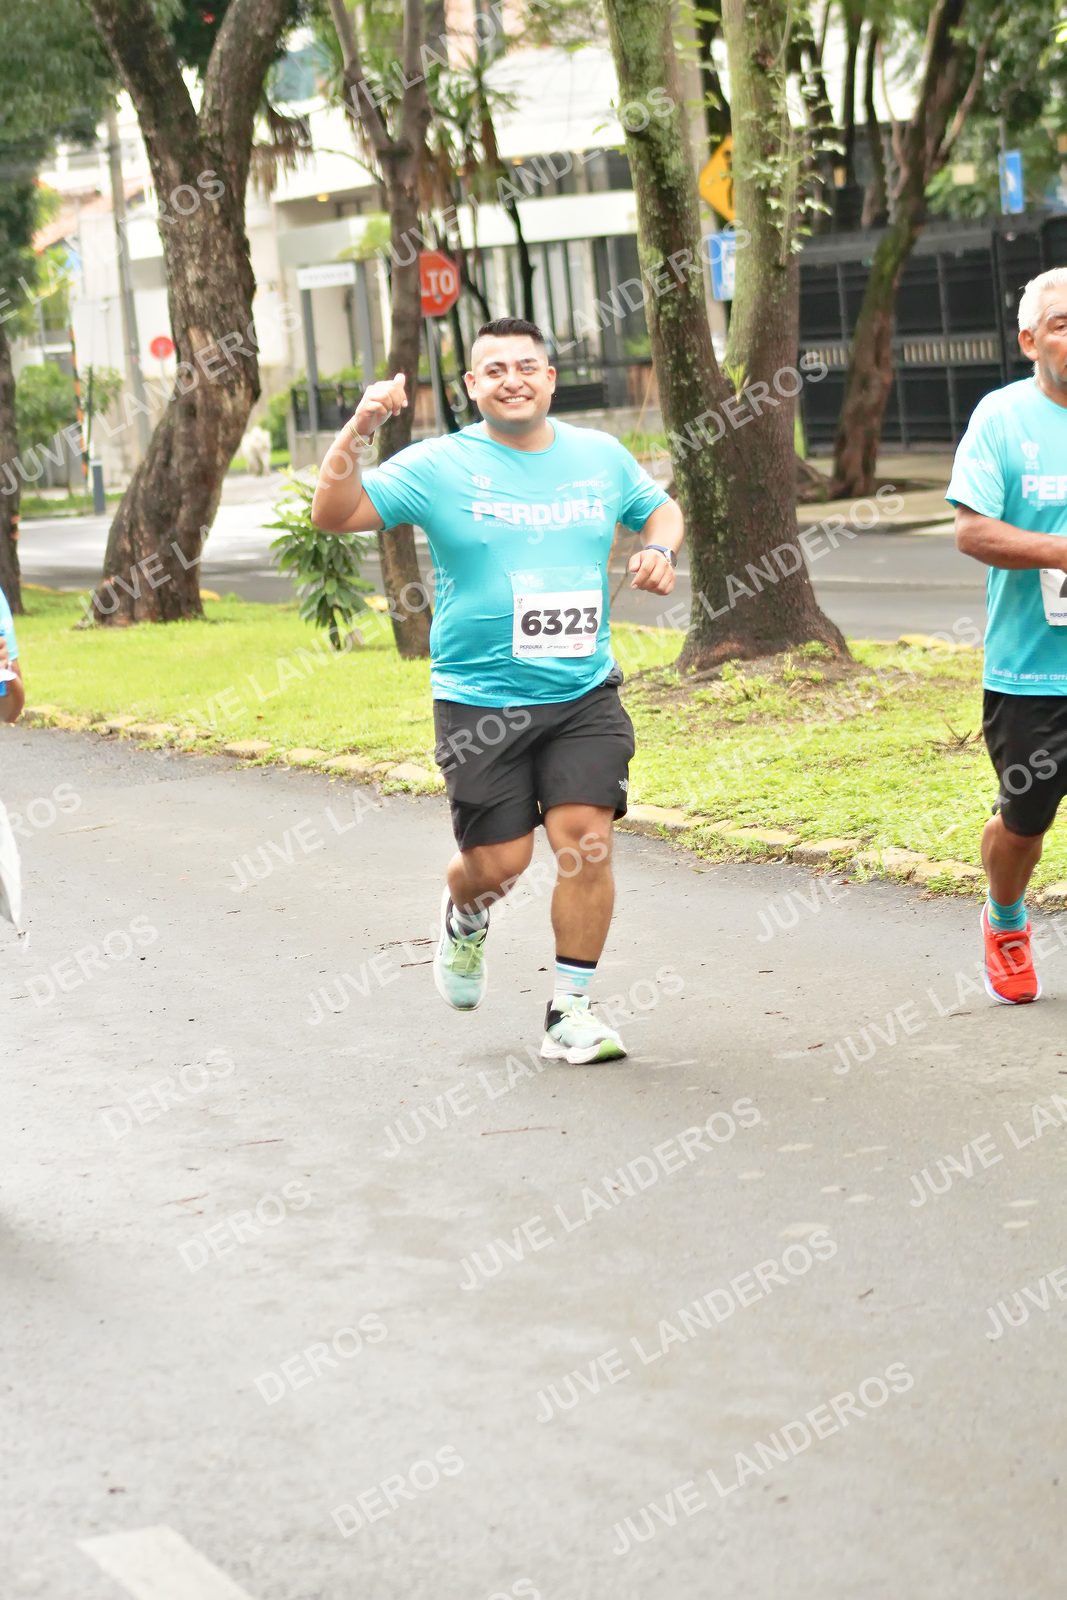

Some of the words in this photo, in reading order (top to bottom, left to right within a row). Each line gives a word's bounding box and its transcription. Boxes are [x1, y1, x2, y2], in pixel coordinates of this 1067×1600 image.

[421, 270, 455, 296] LTO
[472, 498, 606, 525] PERDURA
[521, 607, 598, 636] 6323
